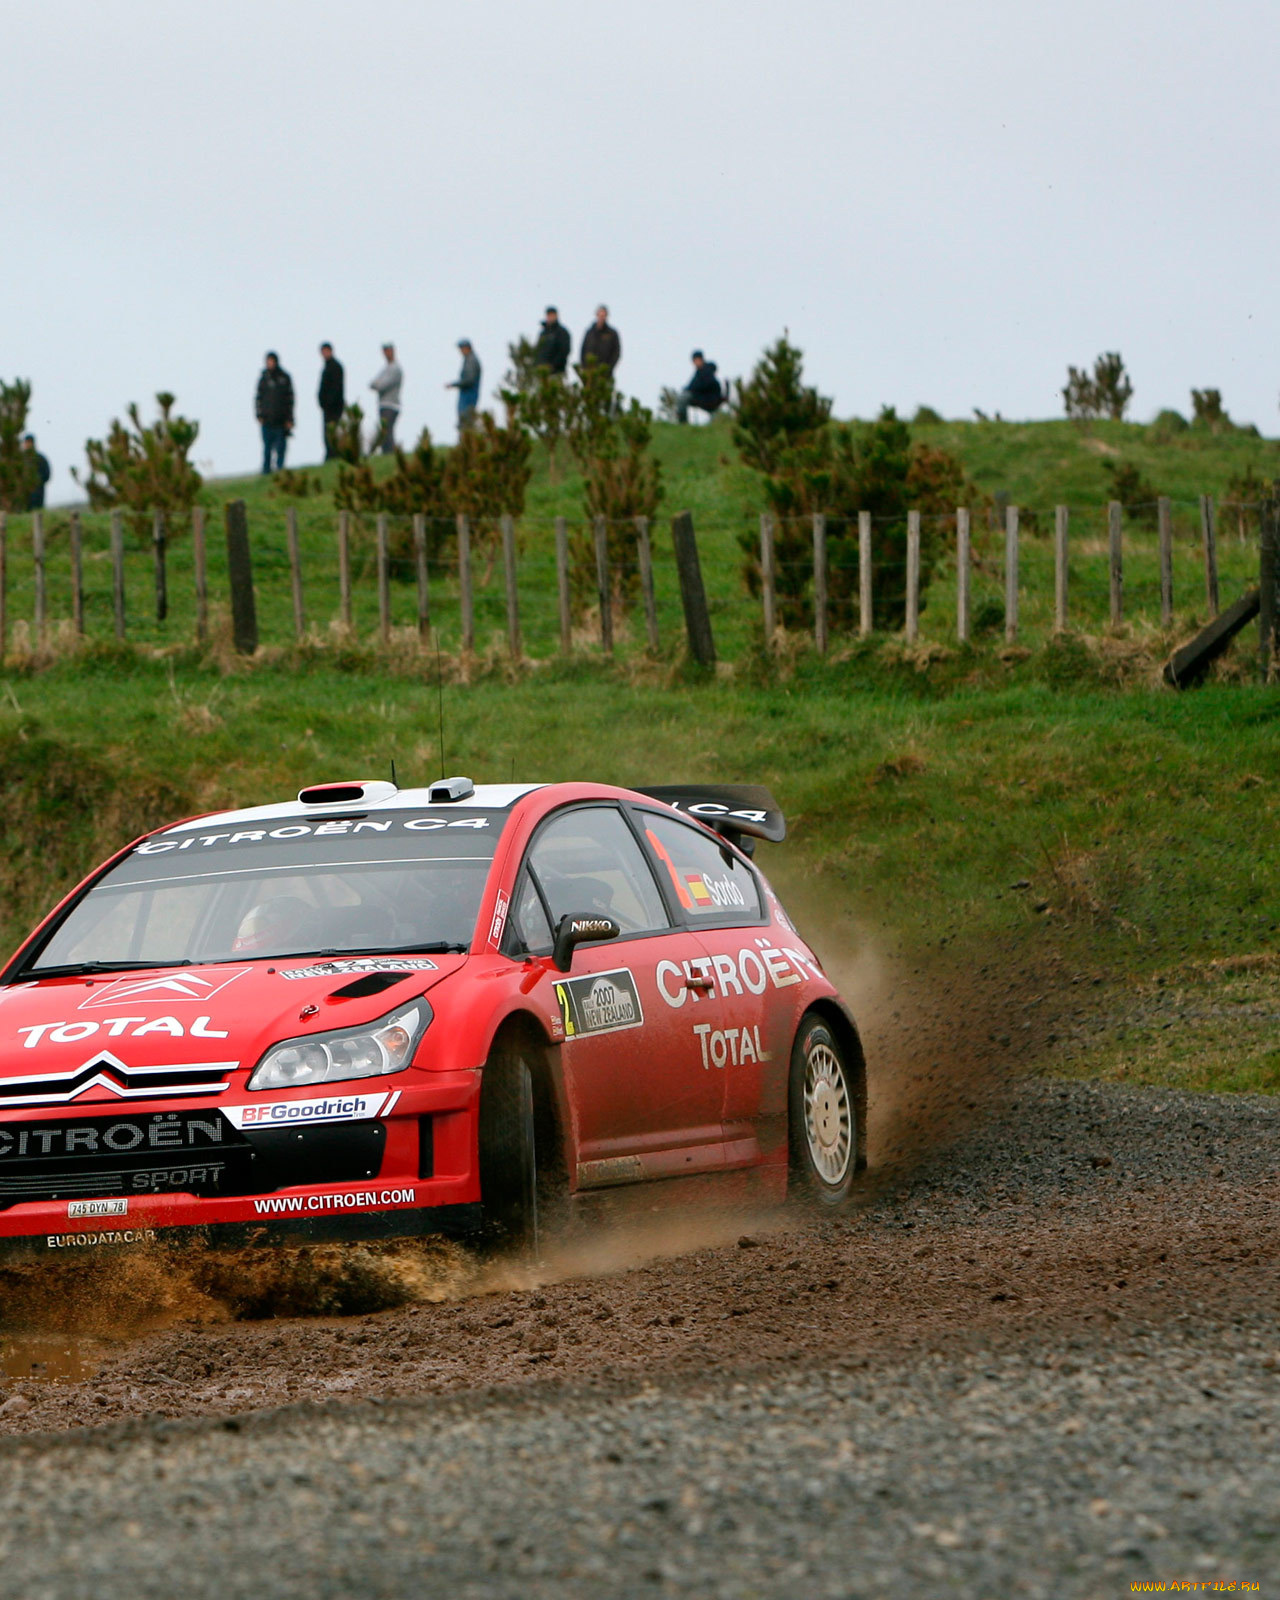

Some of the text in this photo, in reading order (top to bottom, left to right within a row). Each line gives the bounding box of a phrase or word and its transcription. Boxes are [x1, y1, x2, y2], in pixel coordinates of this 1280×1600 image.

[687, 803, 768, 823] C4
[137, 816, 491, 855] CITROËN C4
[702, 872, 745, 906] Sordo
[570, 920, 612, 933] NIKKO
[340, 963, 434, 973] ZEALAND
[656, 937, 825, 1009] CITROËN
[593, 986, 615, 1007] 2007
[556, 984, 575, 1035] 2
[585, 1009, 602, 1026] NEW
[603, 1003, 633, 1023] ZEALAND
[17, 1016, 230, 1049] TOTAL
[693, 1023, 773, 1070] TOTAL
[241, 1098, 367, 1122] BFGoodrich
[131, 1167, 224, 1189] SPORT
[72, 1204, 87, 1215] 745
[89, 1203, 108, 1213] DYN
[253, 1188, 415, 1214] WWW.CITROEN.COM
[46, 1229, 158, 1248] EURODATACAR
